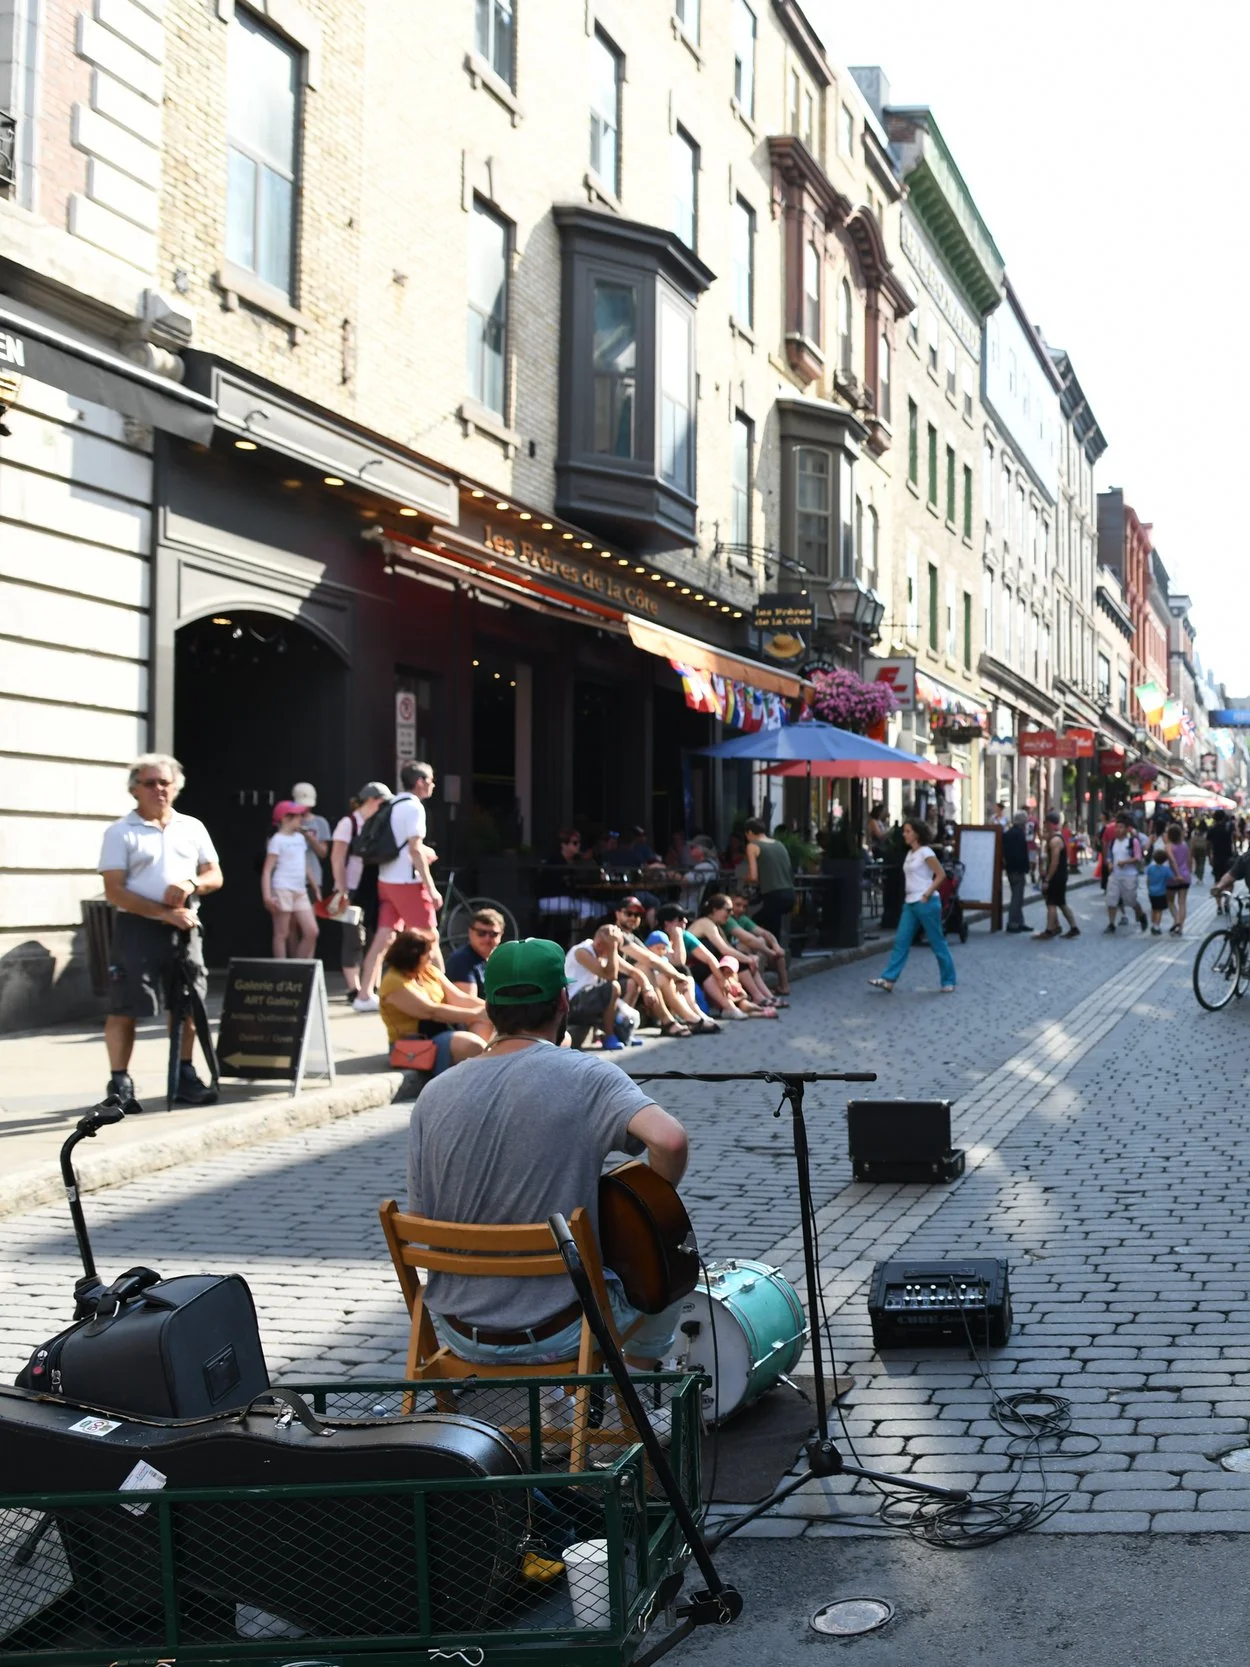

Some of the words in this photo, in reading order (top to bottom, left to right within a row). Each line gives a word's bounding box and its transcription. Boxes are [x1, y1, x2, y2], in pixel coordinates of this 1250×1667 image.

[484, 525, 516, 555] les
[520, 540, 579, 584] Frères
[582, 568, 602, 589] de
[607, 578, 622, 600] la
[624, 586, 659, 615] Côte
[234, 979, 273, 991] Galerie
[275, 980, 303, 992] d'Art
[244, 995, 265, 1005] ART
[265, 996, 300, 1008] Gallery
